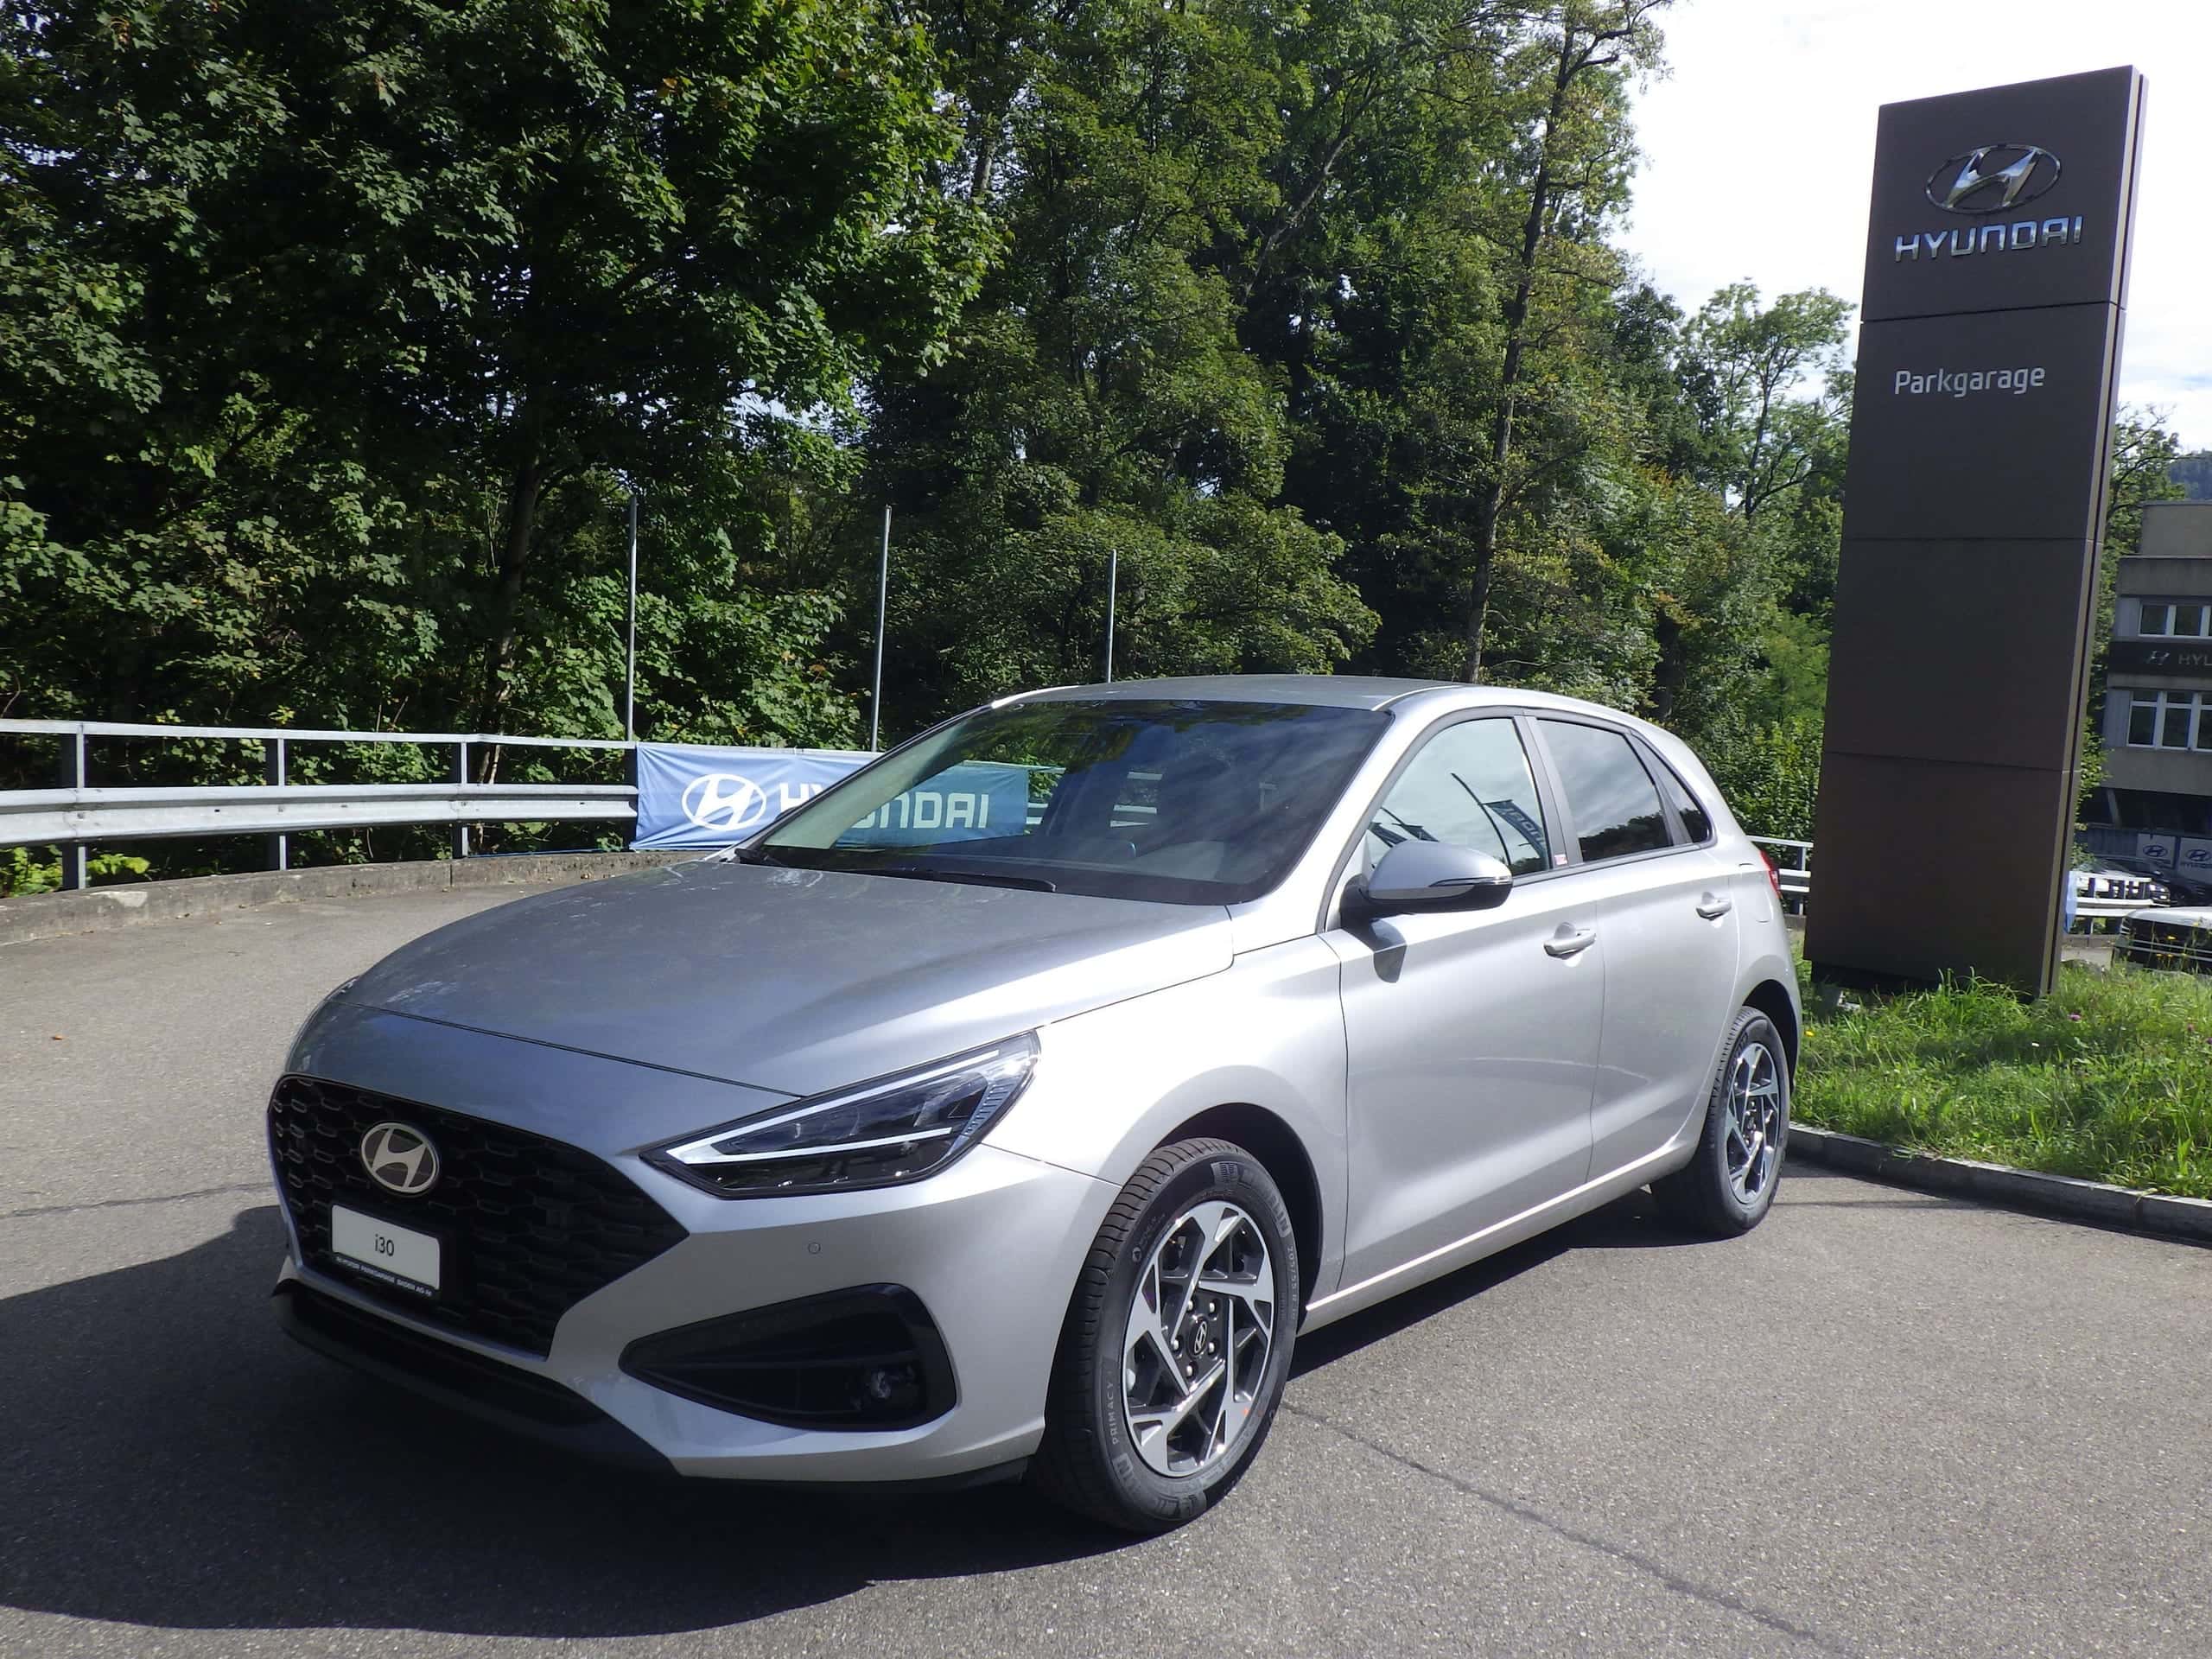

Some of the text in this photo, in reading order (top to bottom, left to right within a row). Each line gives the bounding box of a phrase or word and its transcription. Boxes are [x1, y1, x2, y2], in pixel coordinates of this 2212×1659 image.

[1895, 216, 2082, 262] HYUNDAI
[375, 370, 395, 393] i30
[1894, 365, 2045, 397] Parkgarage
[780, 783, 988, 829] HNDAI
[1107, 1382, 1119, 1445] PRIMACY
